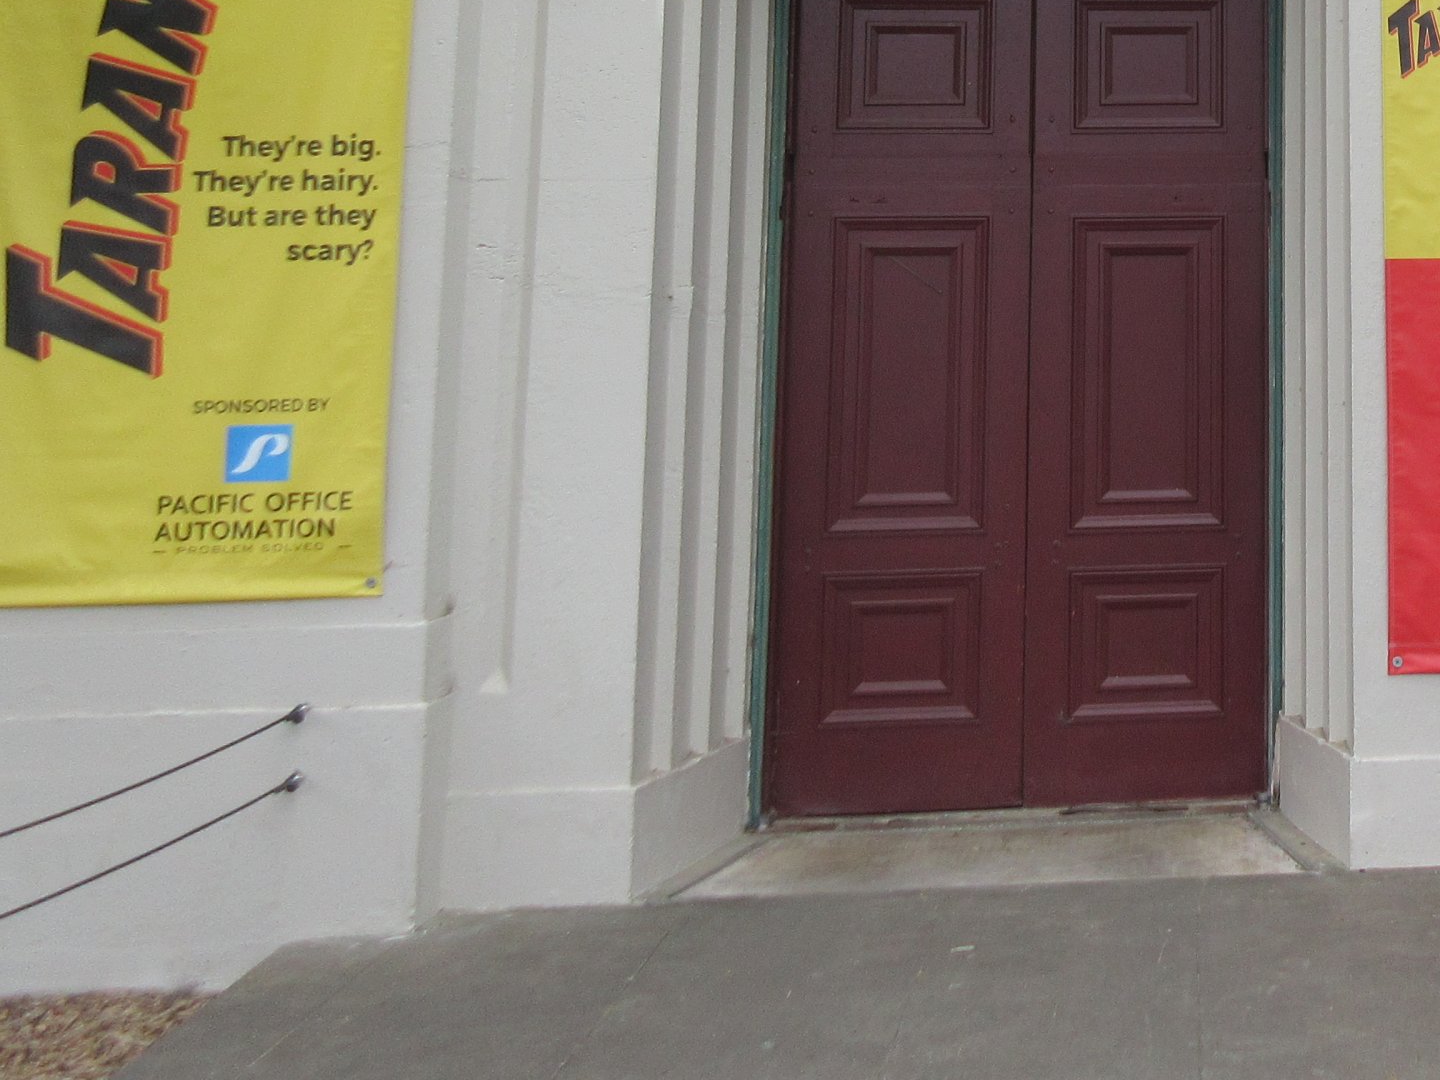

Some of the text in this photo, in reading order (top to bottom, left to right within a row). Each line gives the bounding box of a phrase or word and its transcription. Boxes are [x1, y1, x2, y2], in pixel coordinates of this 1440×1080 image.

[222, 133, 381, 163] They're big.
[193, 168, 379, 198] They're hairy.
[207, 204, 377, 231] But are they
[286, 239, 374, 266] scary?
[192, 397, 331, 414] SPONSORED BY
[157, 490, 354, 515] PACIFIC OFFICE
[154, 517, 336, 542] AUTOMATION
